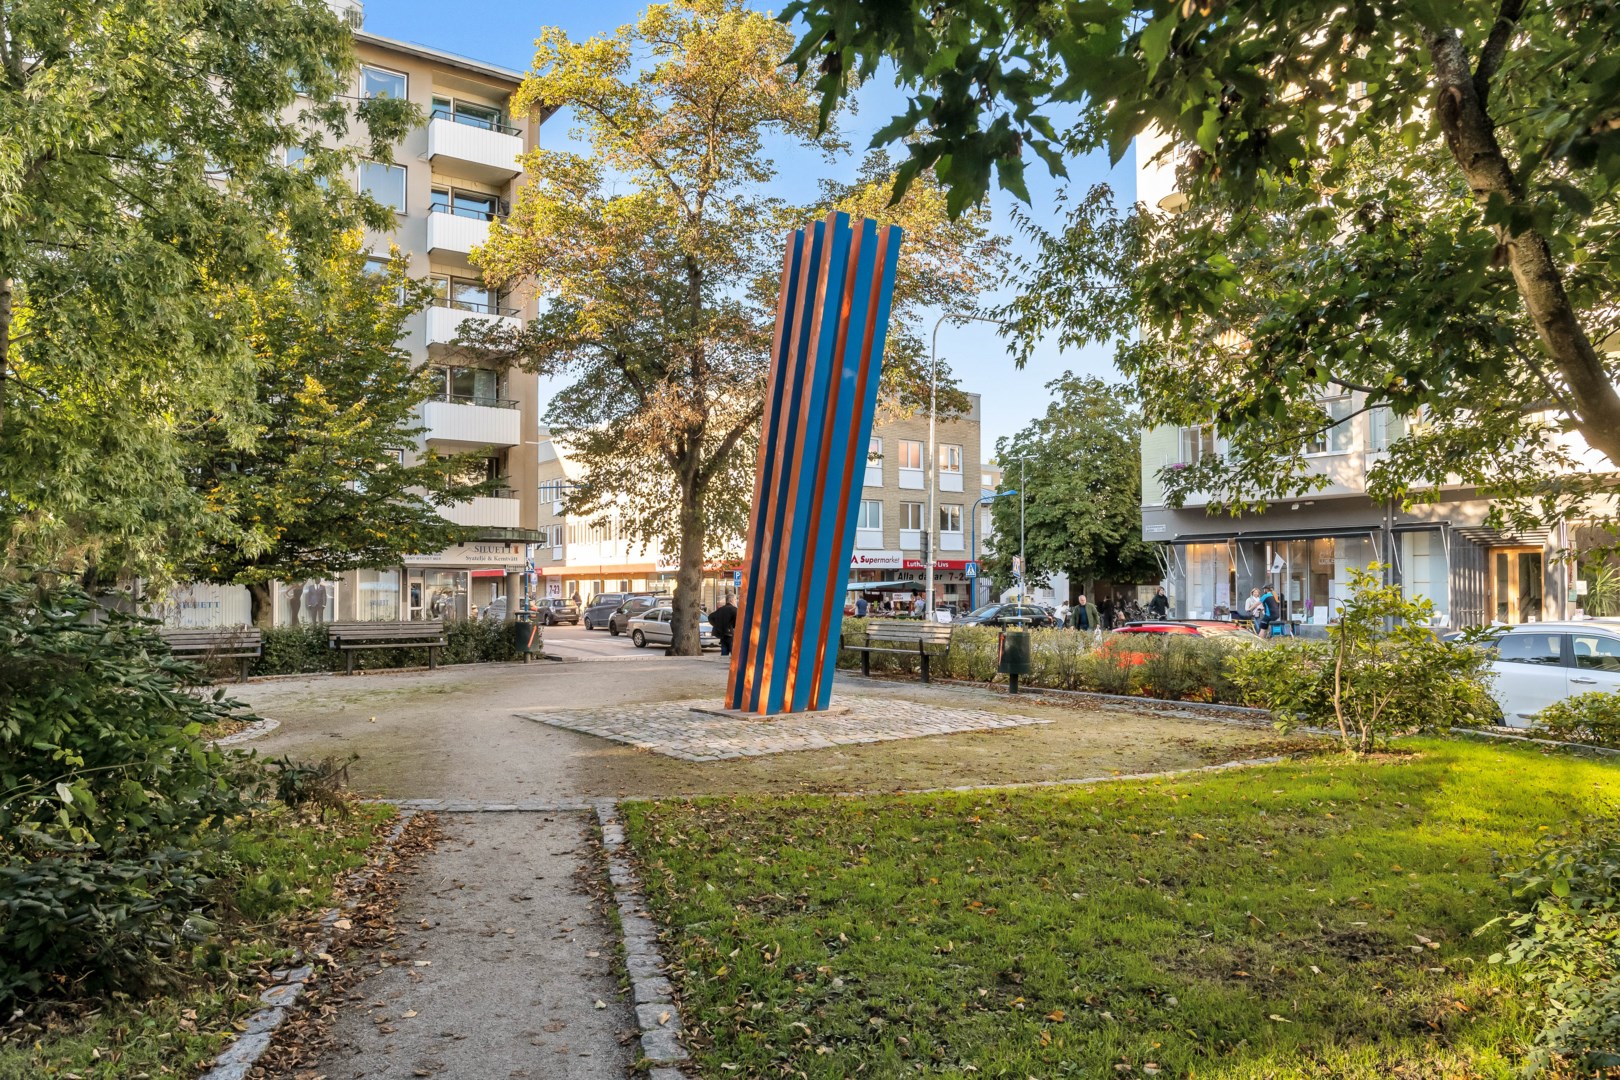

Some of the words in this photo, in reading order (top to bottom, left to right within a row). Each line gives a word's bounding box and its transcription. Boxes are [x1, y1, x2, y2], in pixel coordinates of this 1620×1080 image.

[474, 545, 512, 554] SILUETT
[860, 555, 900, 565] Supermarket
[897, 572, 914, 581] Alla
[919, 572, 943, 581] daar
